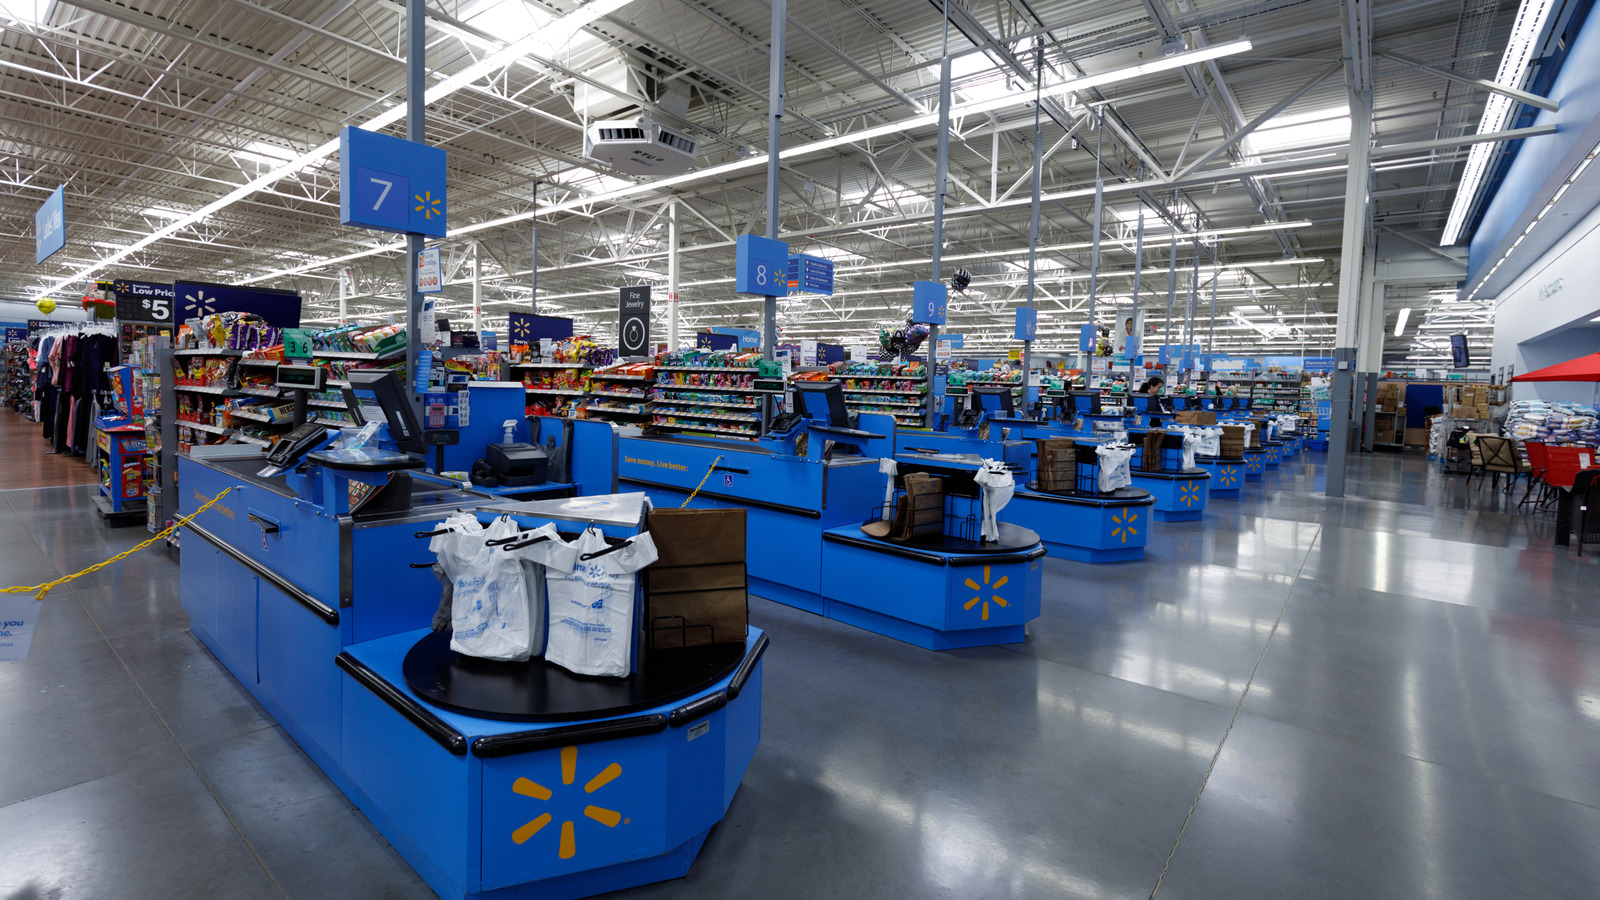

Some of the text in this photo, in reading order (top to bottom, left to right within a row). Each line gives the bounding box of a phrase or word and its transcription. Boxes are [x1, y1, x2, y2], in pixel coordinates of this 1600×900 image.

[633, 150, 656, 159] RTU
[370, 177, 393, 211] 7
[756, 264, 767, 286] 8
[154, 289, 176, 297] Pric
[625, 300, 644, 309] Jewelry
[928, 302, 934, 316] 9
[742, 335, 758, 344] Home
[637, 458, 656, 468] money.
[657, 460, 668, 468] Live
[3, 620, 24, 629] you
